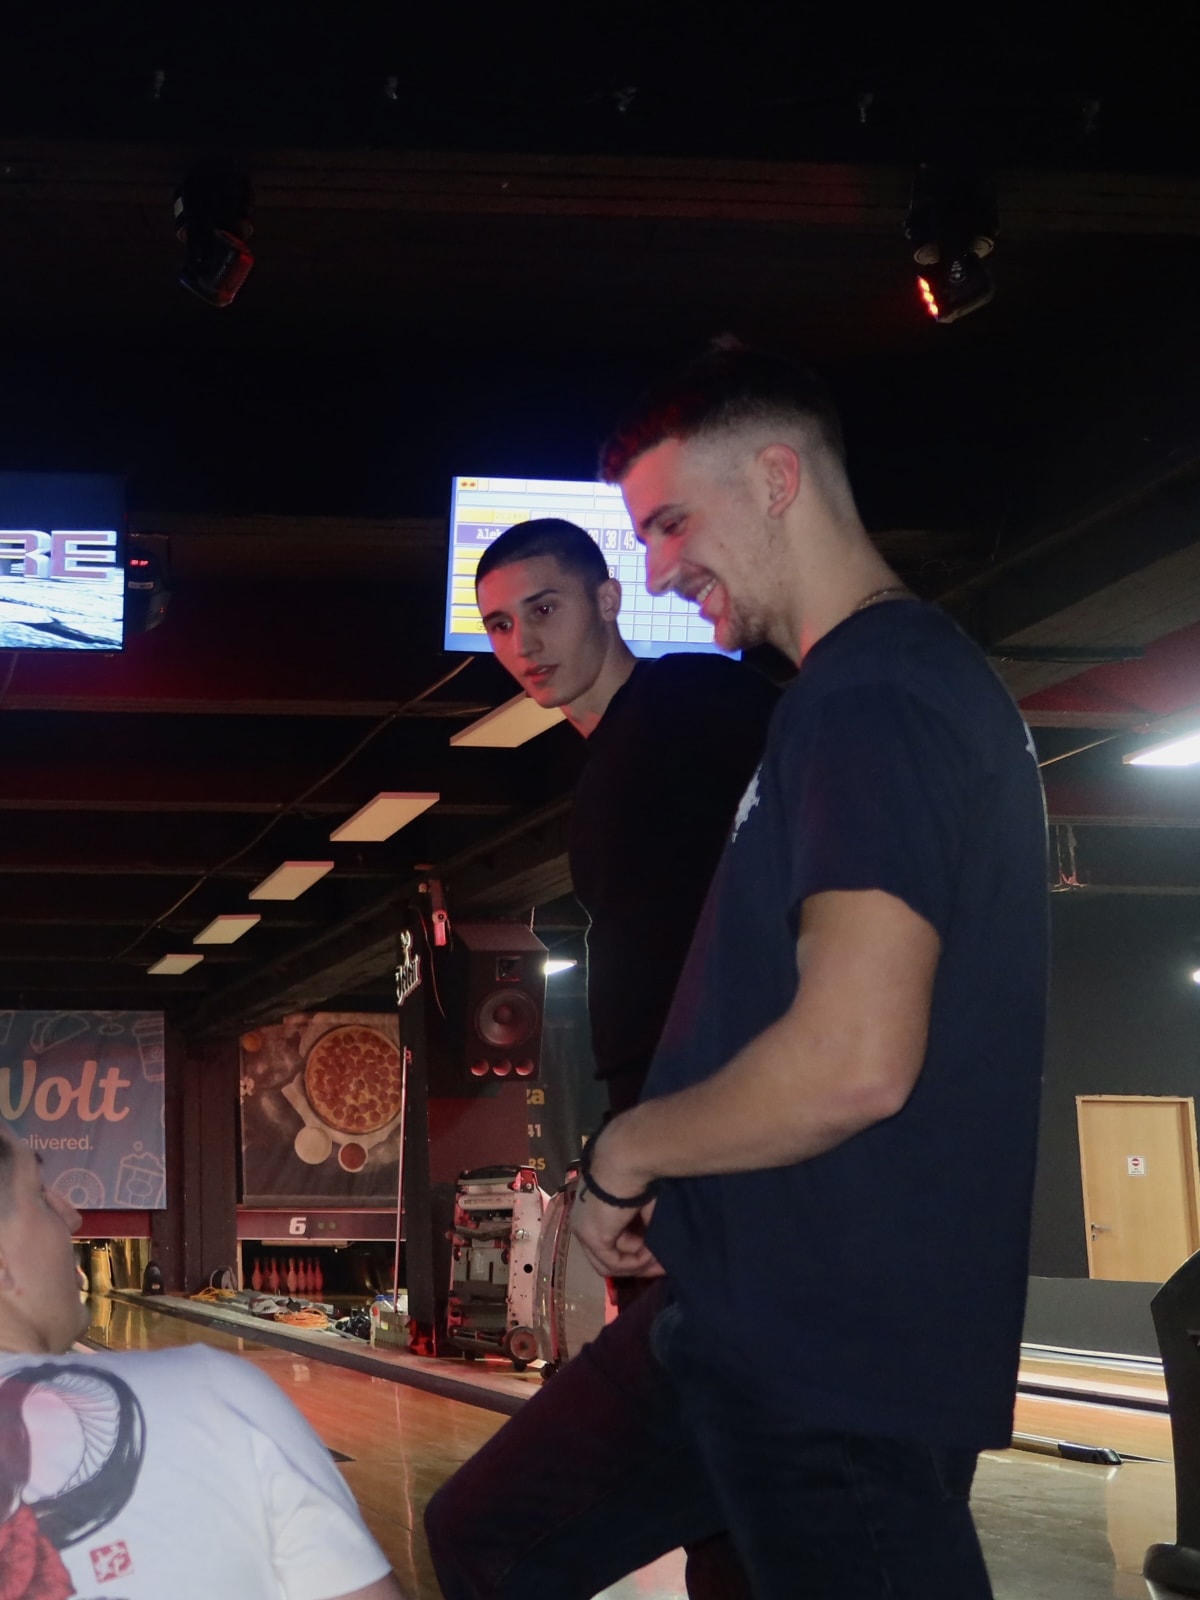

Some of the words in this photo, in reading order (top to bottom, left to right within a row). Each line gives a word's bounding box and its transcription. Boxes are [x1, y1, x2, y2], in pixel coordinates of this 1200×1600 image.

[605, 530, 617, 549] 38
[623, 530, 635, 550] 45
[289, 1216, 307, 1235] 6
